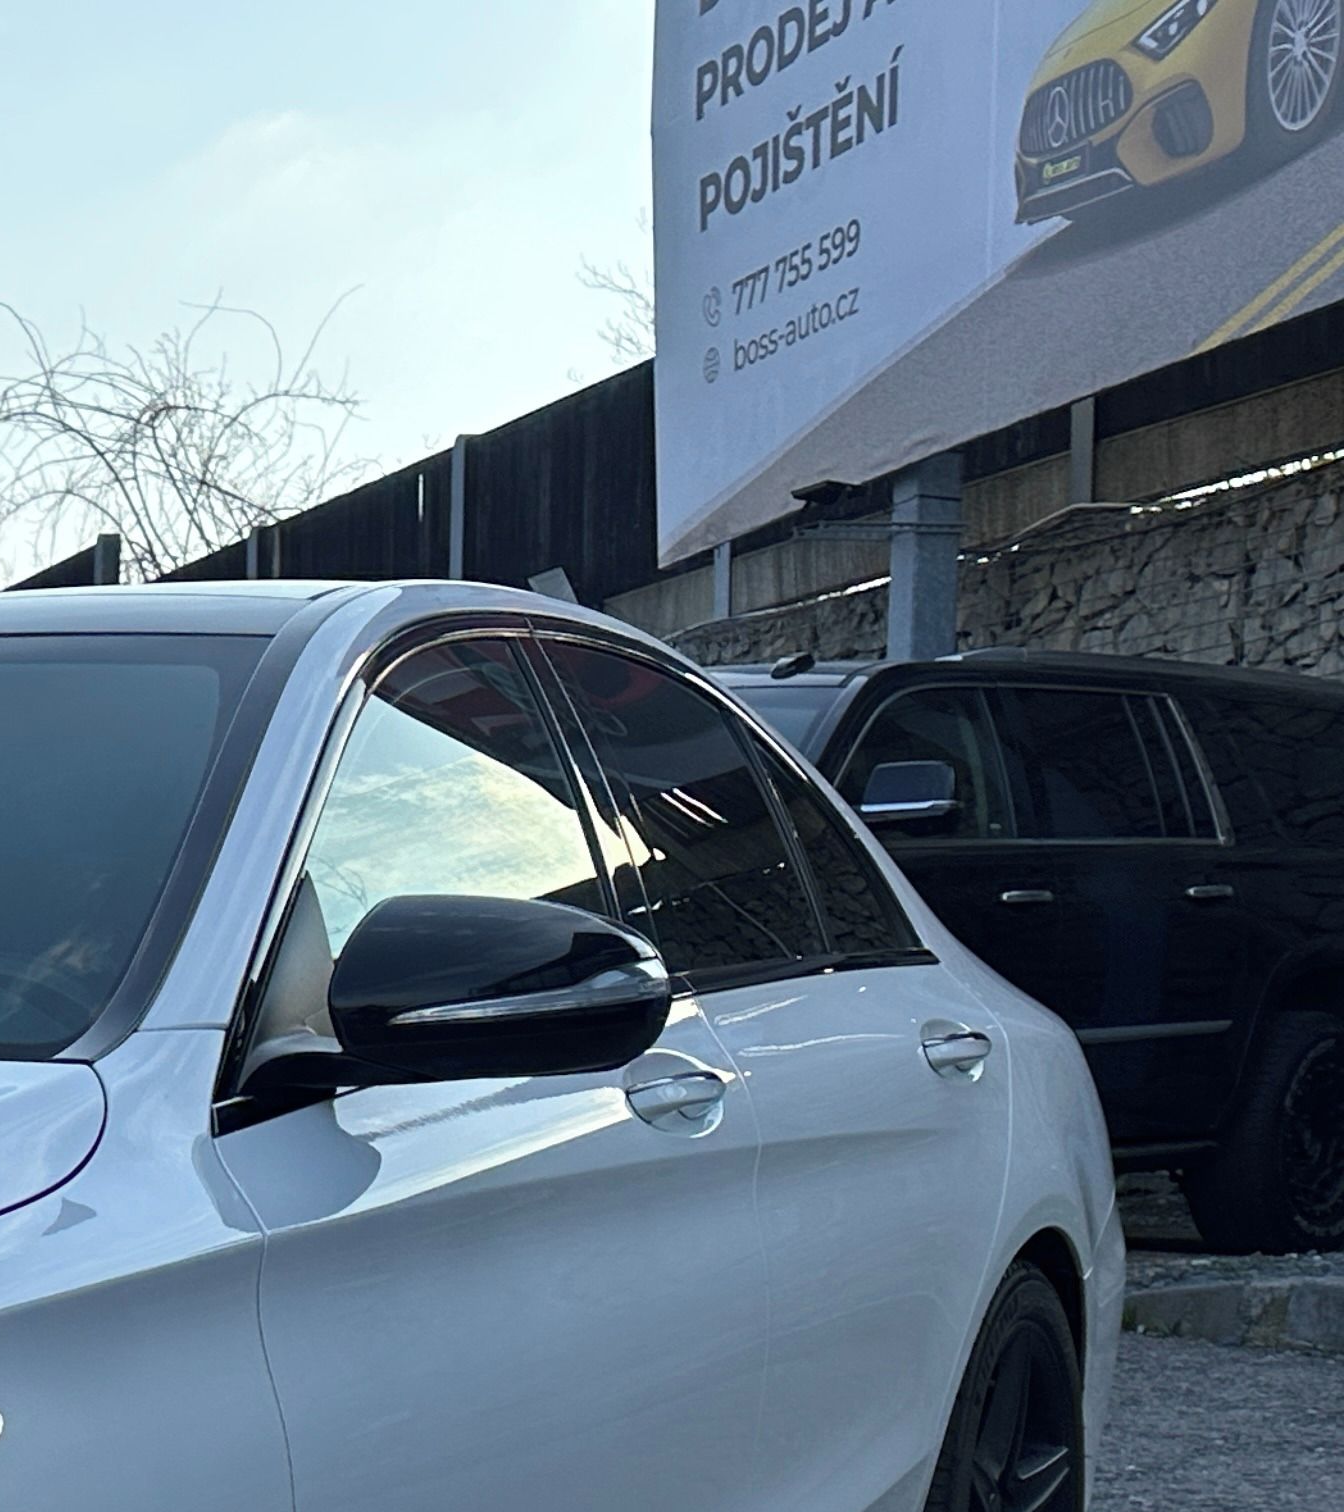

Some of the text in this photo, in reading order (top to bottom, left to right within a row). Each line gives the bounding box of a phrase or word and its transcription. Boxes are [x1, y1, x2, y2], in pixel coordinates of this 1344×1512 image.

[696, 0, 851, 120] PRODEJ
[700, 44, 904, 232] POJIŠTĚNÍ
[732, 219, 861, 315] 777 755 599
[733, 287, 860, 372] boss-auto.cz
